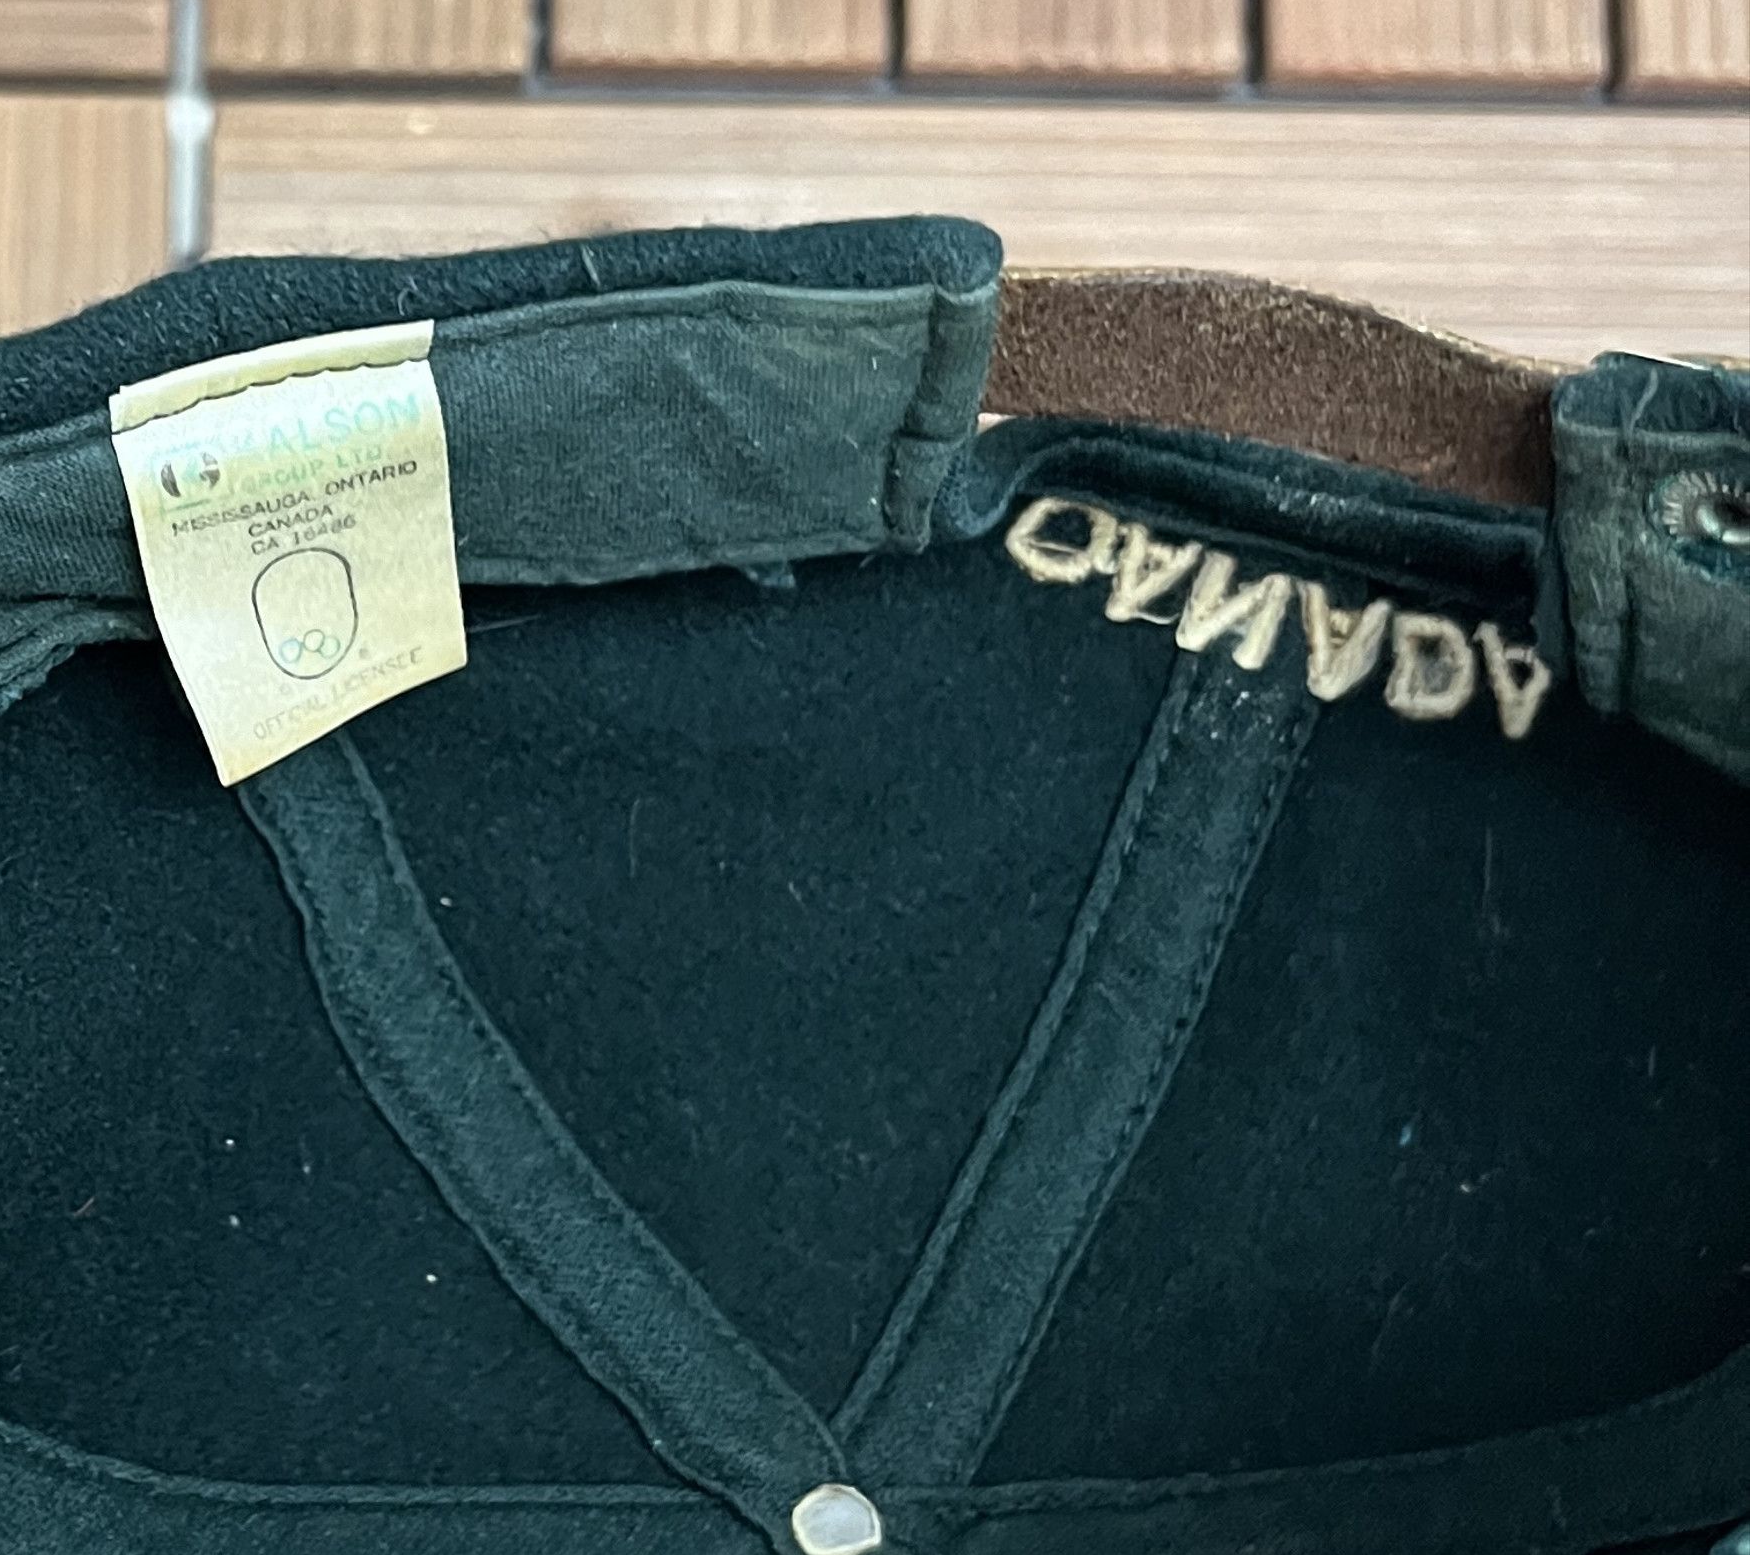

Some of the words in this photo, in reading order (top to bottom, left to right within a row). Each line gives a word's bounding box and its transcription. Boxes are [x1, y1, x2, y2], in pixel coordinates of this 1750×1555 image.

[234, 393, 421, 461] ALSON
[324, 459, 418, 496] ONTARIO
[247, 504, 333, 538] CANADA
